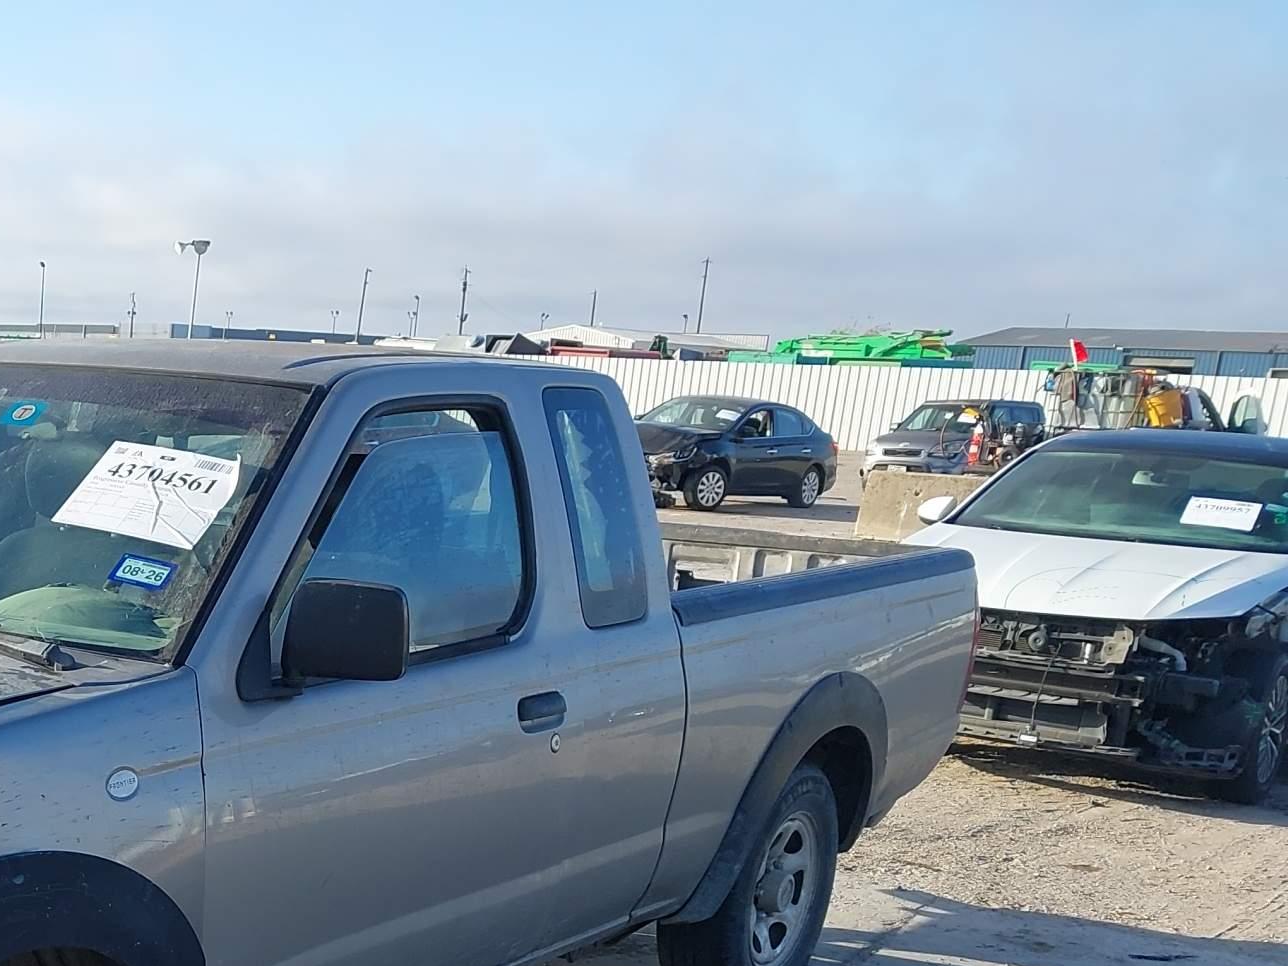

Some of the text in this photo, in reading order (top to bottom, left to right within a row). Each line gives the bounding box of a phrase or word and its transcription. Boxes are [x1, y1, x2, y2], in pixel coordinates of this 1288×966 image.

[107, 462, 218, 494] 43704561
[122, 564, 141, 577] 08
[144, 569, 165, 582] 26
